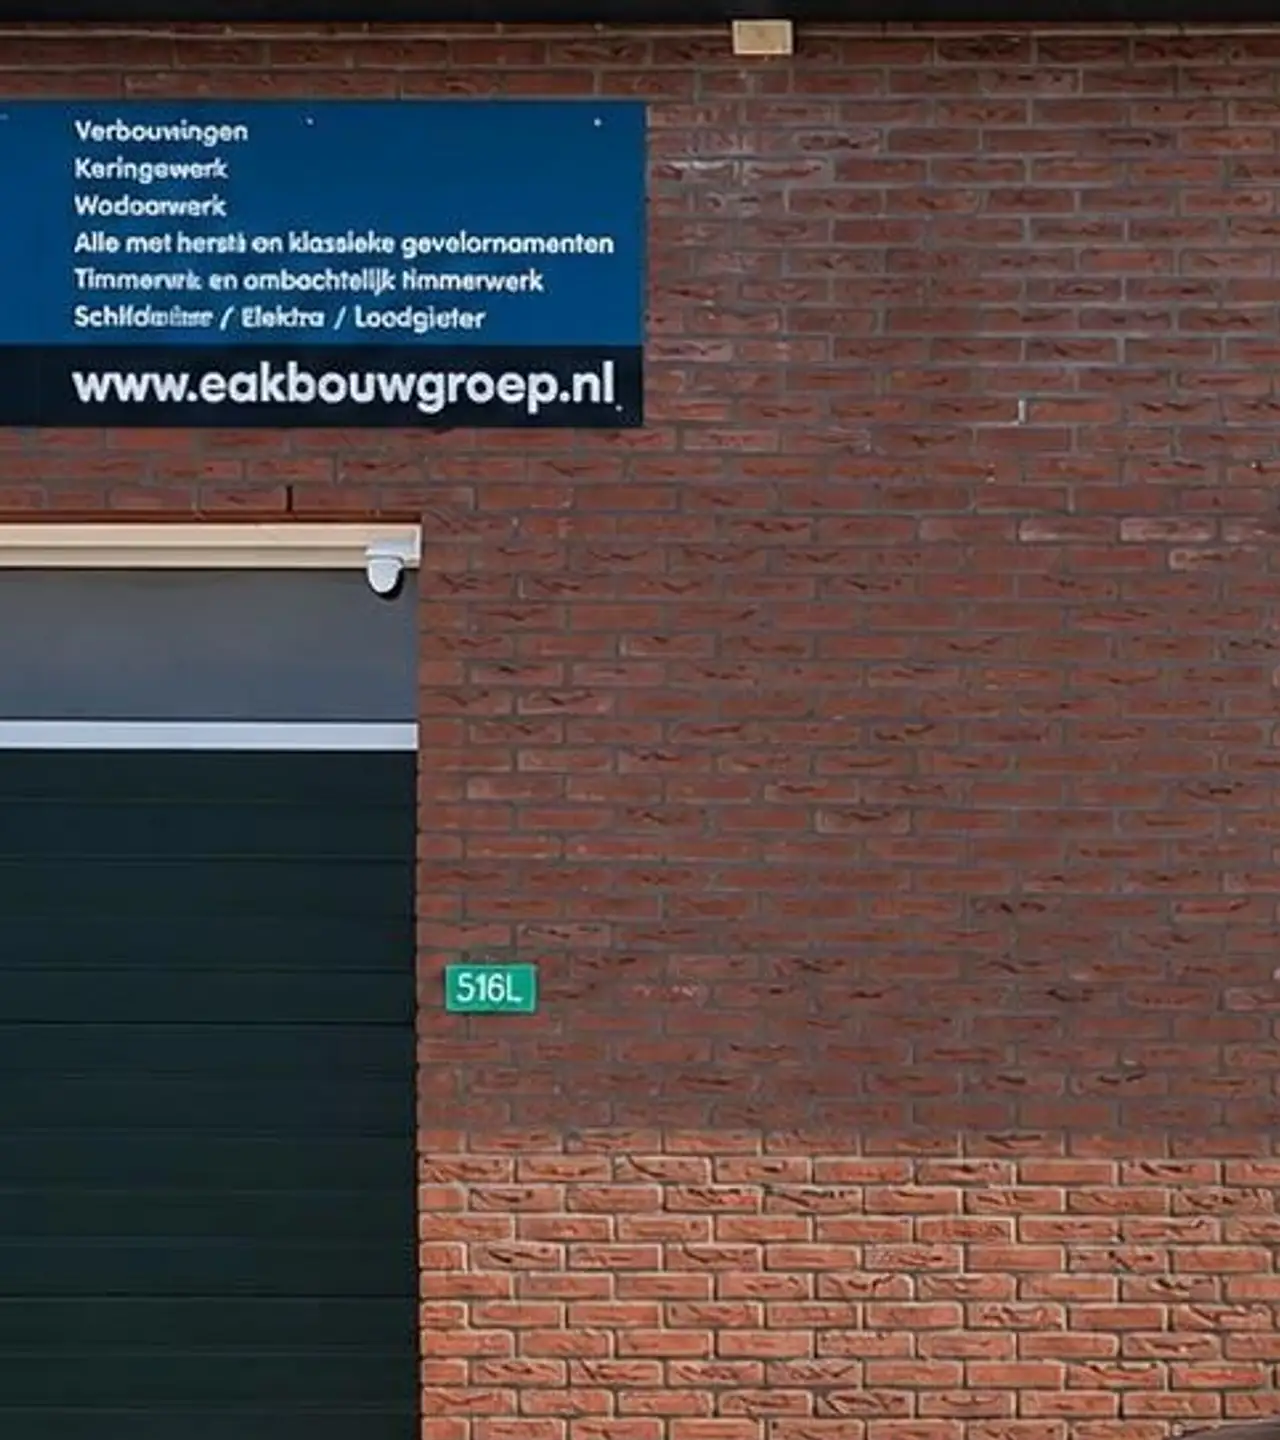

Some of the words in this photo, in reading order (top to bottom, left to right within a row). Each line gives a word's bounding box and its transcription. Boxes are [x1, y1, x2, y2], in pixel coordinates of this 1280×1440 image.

[125, 233, 172, 254] met
[208, 273, 238, 291] en
[71, 360, 614, 414] www.eakbouwgroep.nl
